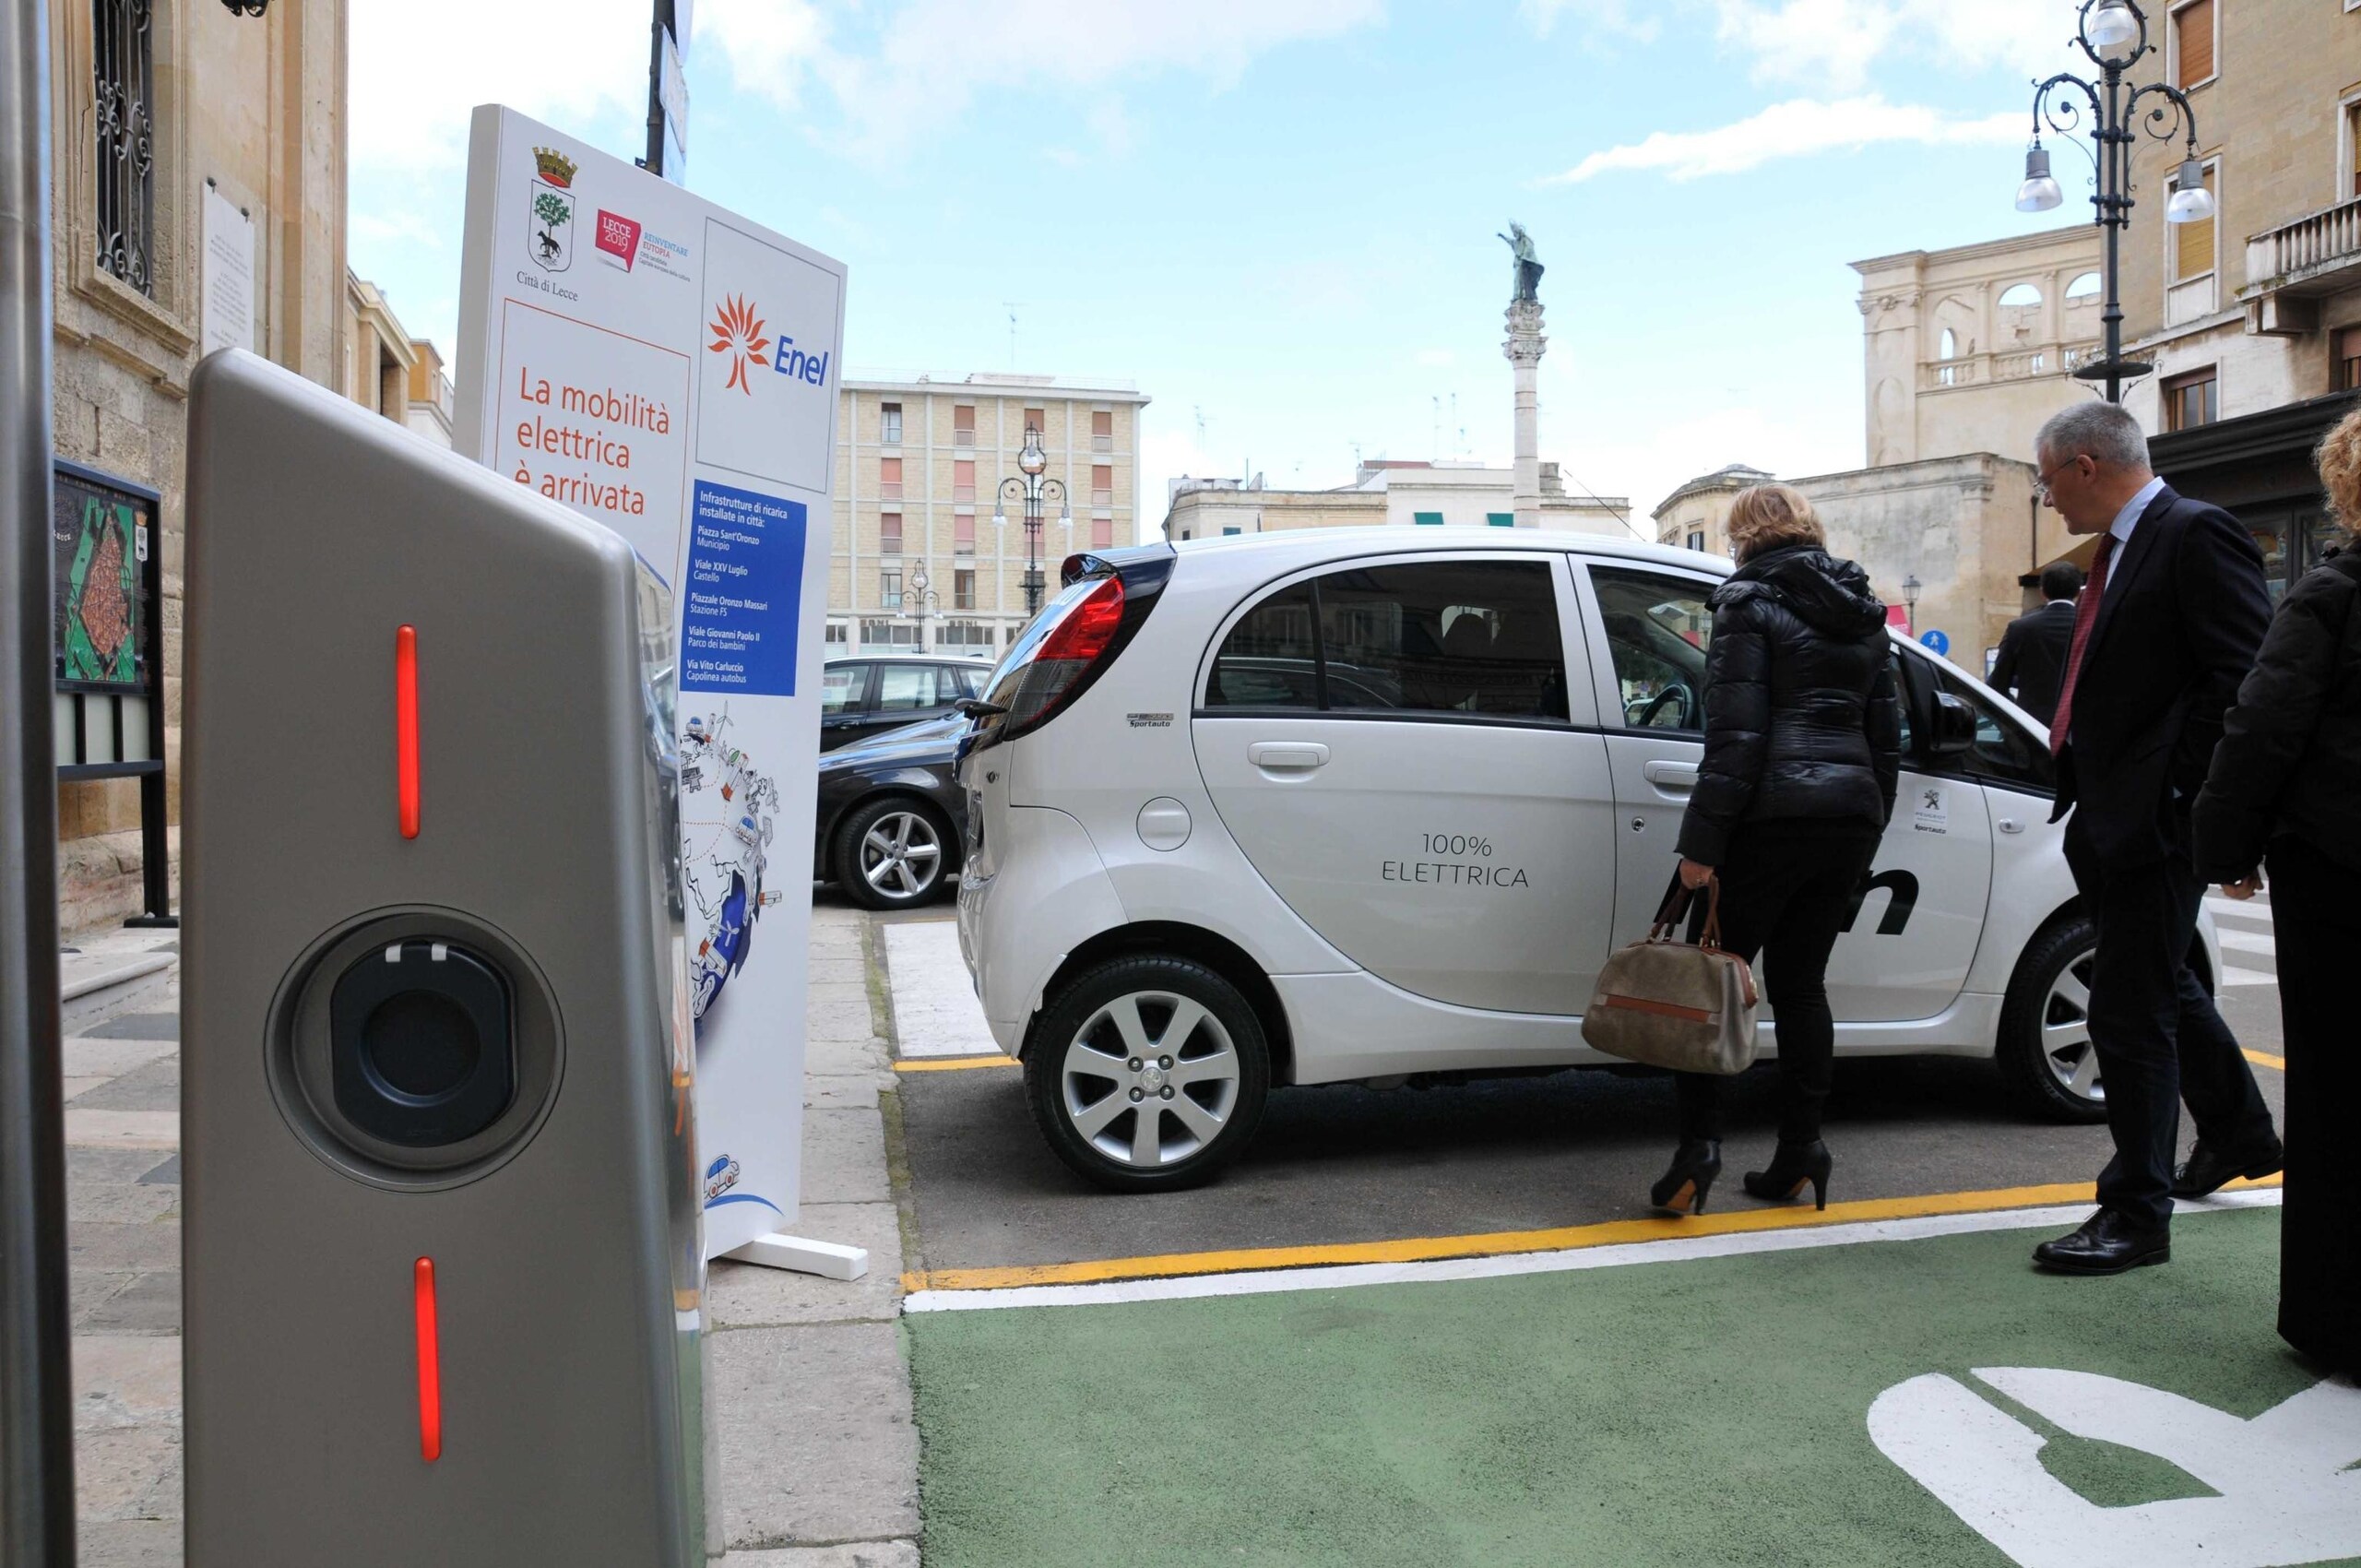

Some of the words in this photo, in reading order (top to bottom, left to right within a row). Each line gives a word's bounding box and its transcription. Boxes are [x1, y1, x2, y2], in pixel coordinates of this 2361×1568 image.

[602, 216, 631, 238] LECCE
[605, 230, 628, 252] 2019
[643, 242, 670, 258] EUTOPIA
[644, 232, 689, 256] REINVENTARE
[516, 270, 539, 289] Città
[540, 279, 550, 292] di
[552, 282, 578, 302] Lecce
[775, 335, 828, 386] Enel
[520, 366, 551, 406] La
[561, 386, 670, 435] mobilità
[516, 415, 630, 469] elettrica
[515, 459, 531, 484] è
[540, 472, 644, 516] arrivata
[700, 491, 753, 512] Infrastrutture
[753, 502, 762, 514] di
[763, 505, 788, 519] ricarica
[699, 505, 736, 522] installate
[737, 512, 745, 524] in
[746, 515, 765, 528] città:
[696, 536, 730, 552] Municipio
[697, 525, 719, 538] Piazza
[720, 529, 760, 545] Sant'Oronzo
[694, 559, 712, 570] Viale
[713, 562, 728, 572] XXV
[728, 564, 748, 576] Luglio
[694, 570, 719, 582] Castello
[690, 603, 719, 616] Stazione
[719, 607, 728, 617] FS
[691, 592, 718, 604] Piazzale
[719, 596, 743, 608] Oronzo
[743, 599, 768, 611] Massari
[687, 636, 706, 647] Parco
[707, 638, 718, 648] dei
[719, 639, 746, 651] bambini
[688, 625, 706, 636] Viale
[706, 627, 736, 639] Giovanni
[737, 630, 754, 641] Paolo
[755, 632, 761, 642] II
[687, 659, 698, 670] Via
[699, 659, 714, 671] Vito
[715, 661, 744, 672] Carluccio
[686, 670, 719, 683] Capolinea
[720, 674, 747, 683] autobus
[1130, 719, 1171, 729] Sportauto
[1422, 833, 1492, 857] 100%
[1382, 861, 1529, 888] ELETTRICA
